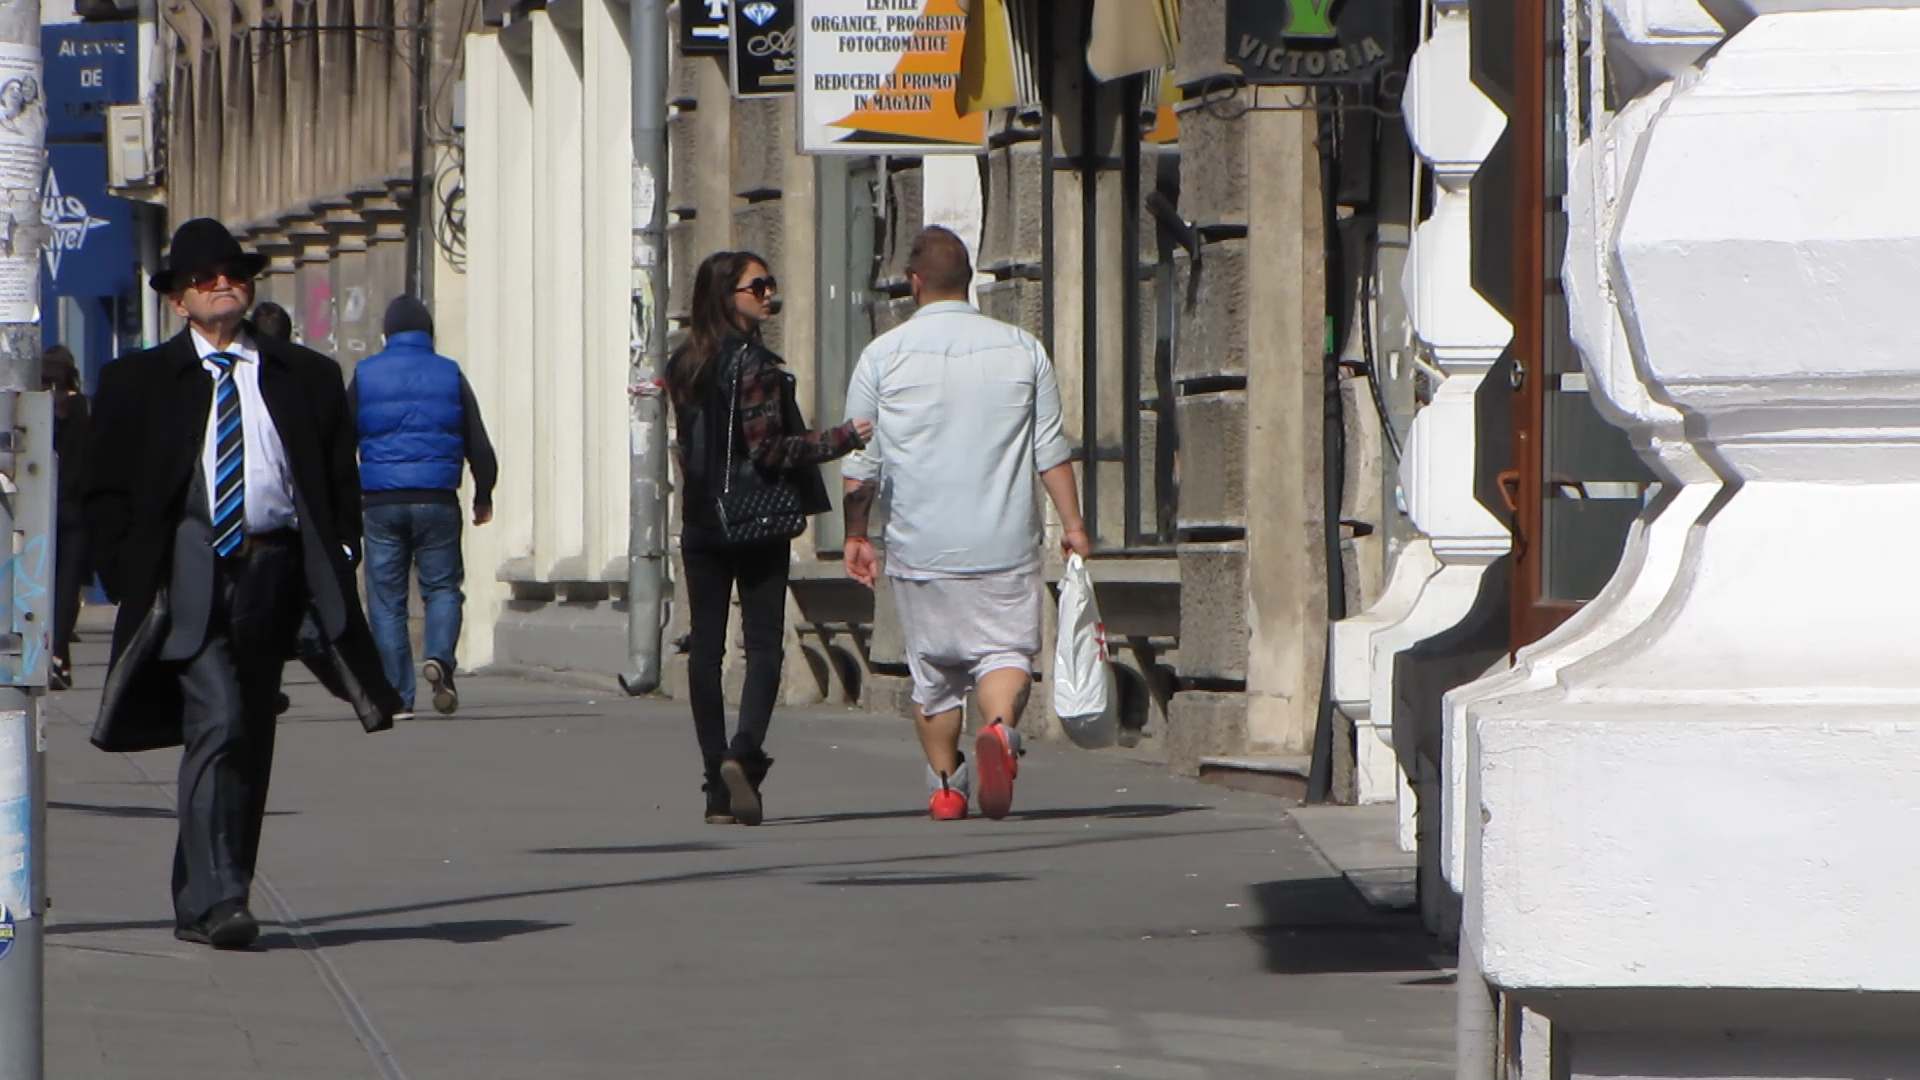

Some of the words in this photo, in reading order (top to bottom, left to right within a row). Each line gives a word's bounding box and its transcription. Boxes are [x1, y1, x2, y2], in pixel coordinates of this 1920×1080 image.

[811, 15, 882, 34] ORGANICE,
[838, 35, 948, 53] FOTOCROMATICE
[1238, 33, 1384, 76] VICTORIA
[80, 69, 103, 88] DE
[814, 73, 881, 90] REDUCERI
[854, 93, 868, 111] IN
[872, 93, 932, 111] MAGAZIN
